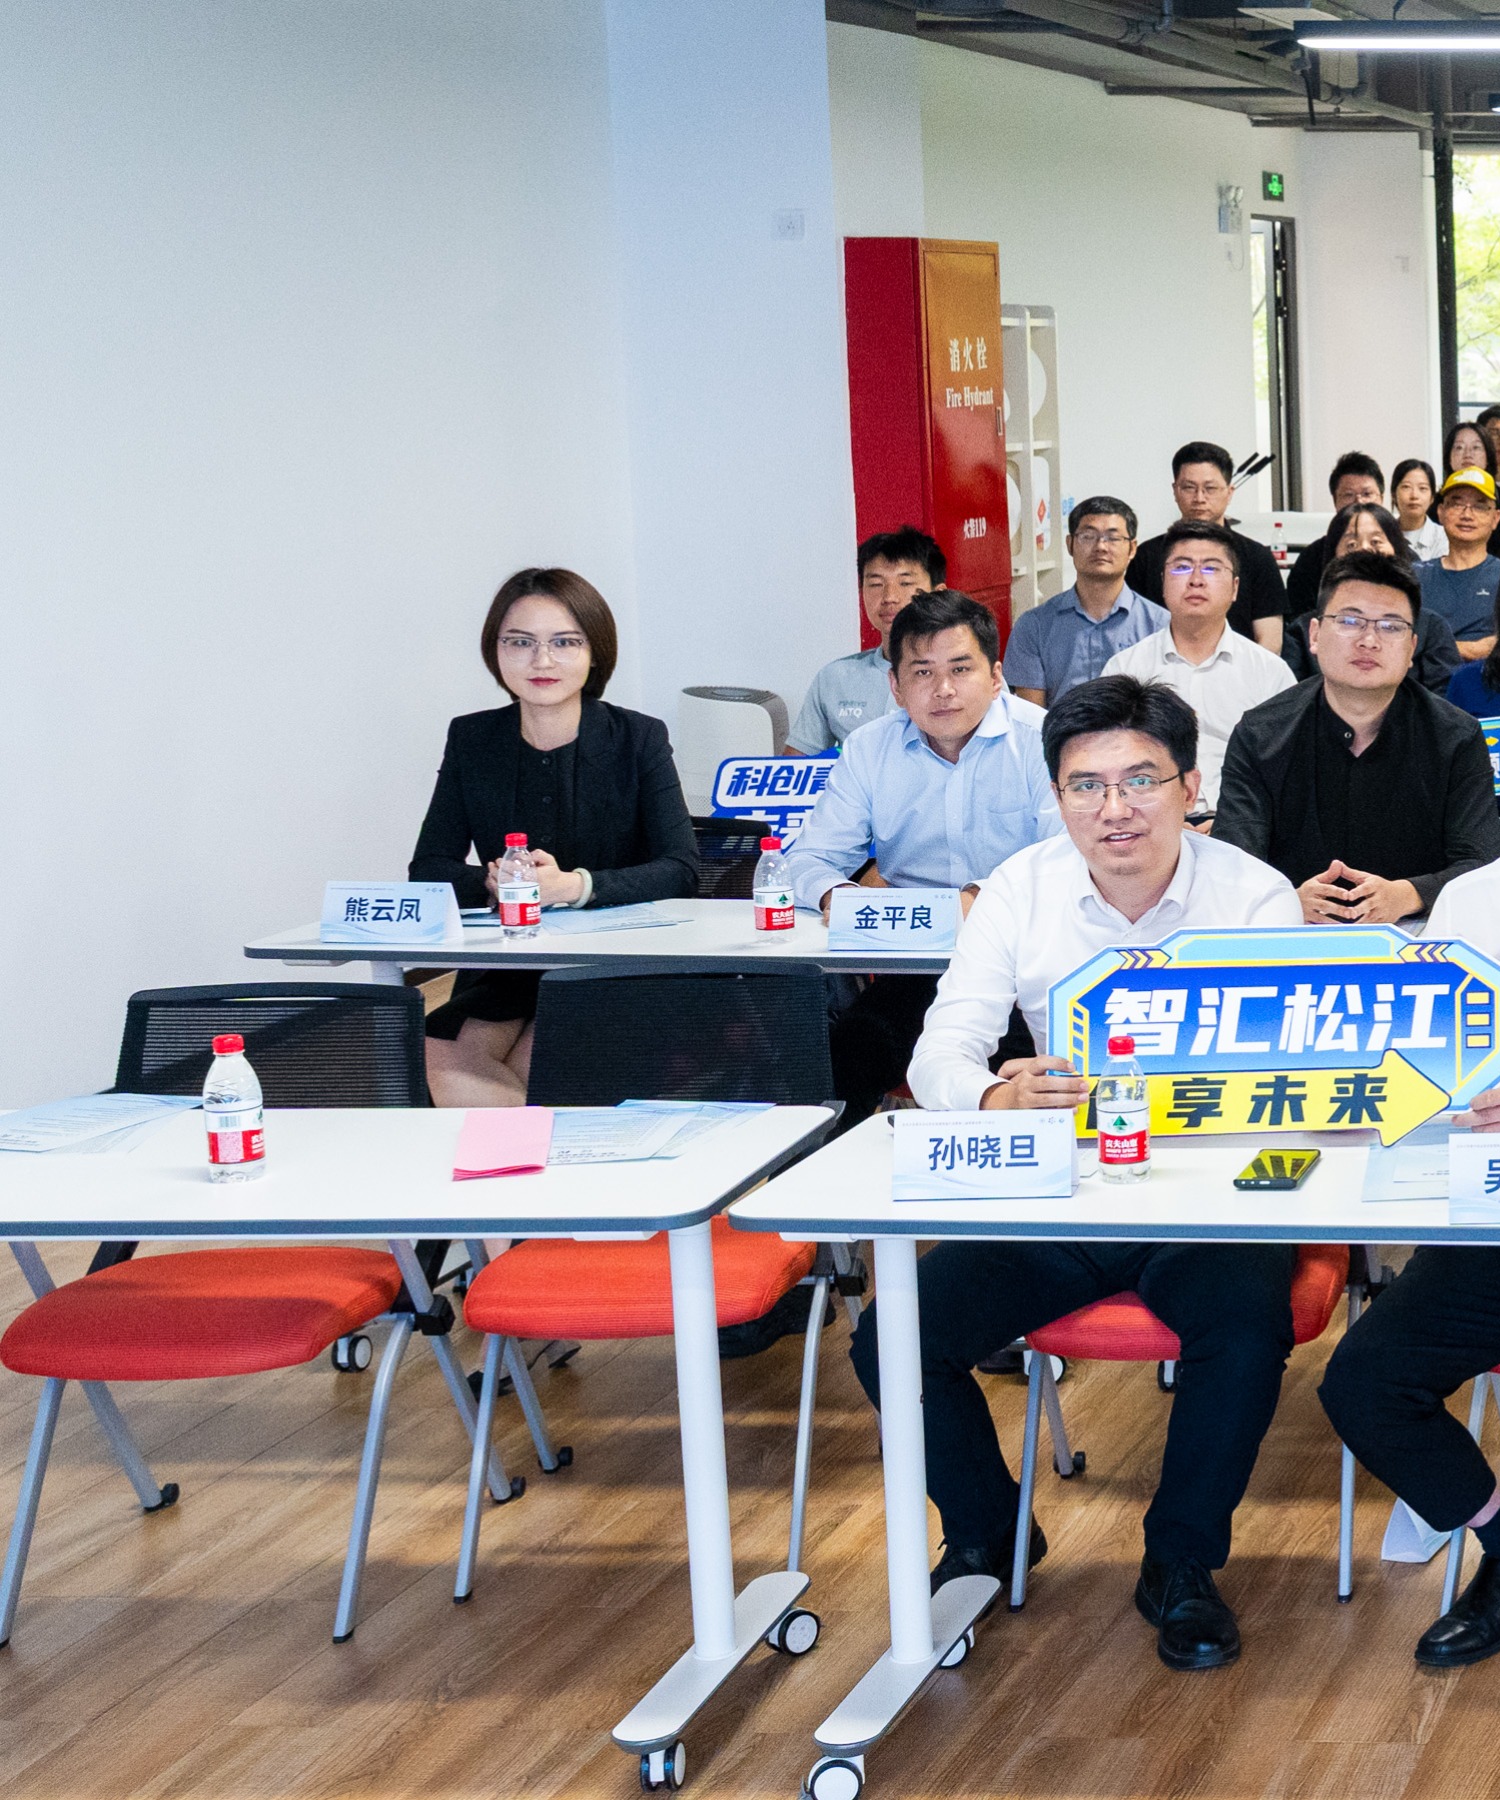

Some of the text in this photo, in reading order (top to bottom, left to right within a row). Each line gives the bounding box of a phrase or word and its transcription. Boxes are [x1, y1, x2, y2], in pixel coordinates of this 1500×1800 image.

[949, 336, 988, 373] 消火栓
[946, 386, 994, 412] Fire Hydrant
[344, 896, 422, 923] 熊云凤
[854, 904, 933, 931] 金平良
[1104, 984, 1452, 1057] 智汇松江
[1086, 1072, 1389, 1130] 享未来
[928, 1134, 1039, 1171] 孙晓旦
